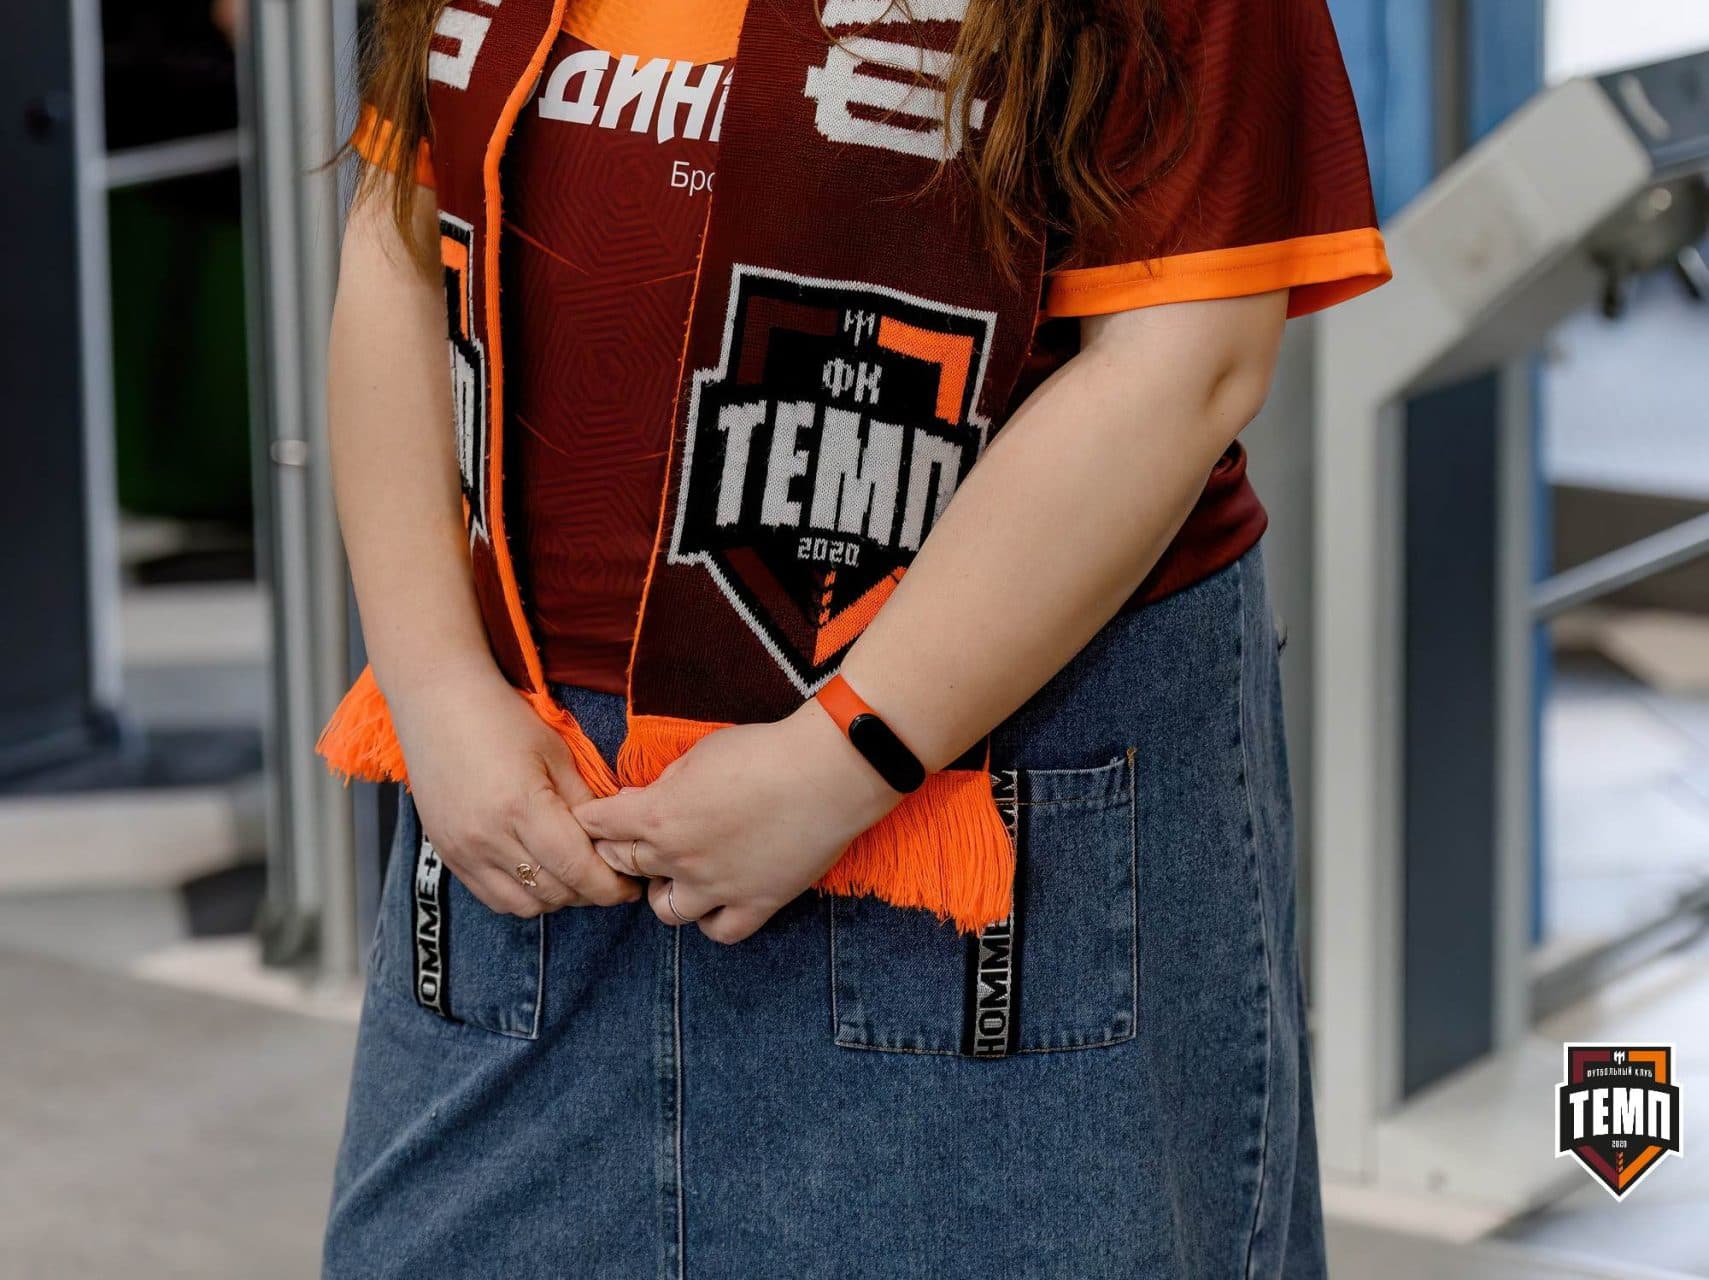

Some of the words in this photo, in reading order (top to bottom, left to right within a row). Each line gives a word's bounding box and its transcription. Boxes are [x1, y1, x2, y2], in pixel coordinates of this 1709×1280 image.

[822, 357, 883, 404] ФК
[716, 400, 962, 551] ТЕМП
[798, 537, 860, 567] 2020
